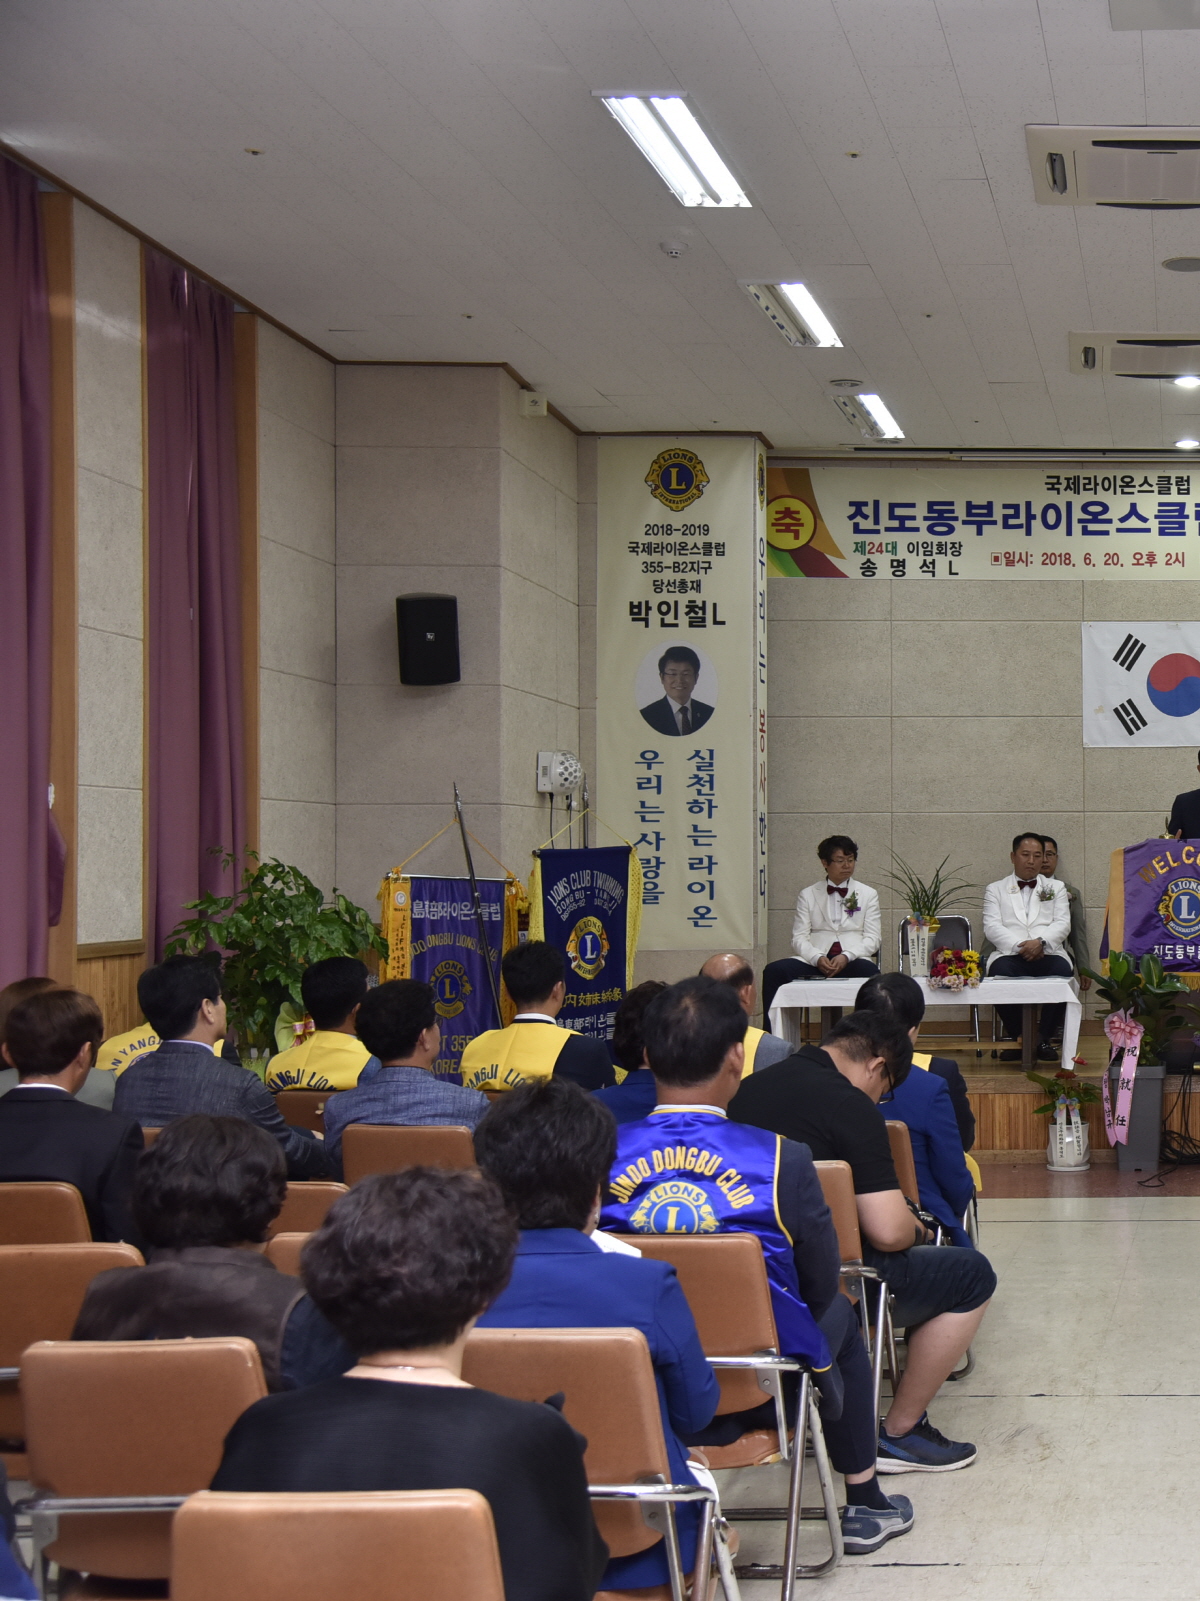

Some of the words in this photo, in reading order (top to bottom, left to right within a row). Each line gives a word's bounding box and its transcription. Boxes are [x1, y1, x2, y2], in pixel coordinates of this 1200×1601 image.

[661, 452, 695, 463] LIONS
[669, 467, 687, 490] L
[1045, 474, 1191, 496] 국제라이온스클럽
[658, 491, 697, 505] INTERNATIONAL
[644, 523, 710, 536] 2018-2019
[771, 506, 805, 541] 축
[627, 541, 726, 556] 국제라이온스클럽
[853, 540, 898, 556] 제24대
[906, 540, 963, 556] 이임회장
[641, 560, 713, 575] 355-B2지구
[1003, 551, 1033, 567] 일시:
[1041, 552, 1076, 568] 2018.
[1083, 552, 1096, 568] 6.
[1103, 552, 1124, 568] 20.
[1131, 550, 1158, 567] 오후
[1165, 551, 1186, 568] 2시
[652, 579, 702, 594] 당선총재
[629, 600, 726, 628] 박인철L
[635, 749, 665, 823] 우리는
[570, 869, 592, 890] CLUB
[1179, 895, 1196, 919] L
[584, 934, 598, 959] L
[436, 961, 464, 974] LIONS
[443, 978, 457, 999] L
[609, 1157, 652, 1205] JINDO
[651, 1145, 724, 1177] DONGBU
[715, 1168, 756, 1210] CLUB
[653, 1183, 701, 1202] LIONS
[664, 1206, 688, 1234] L
